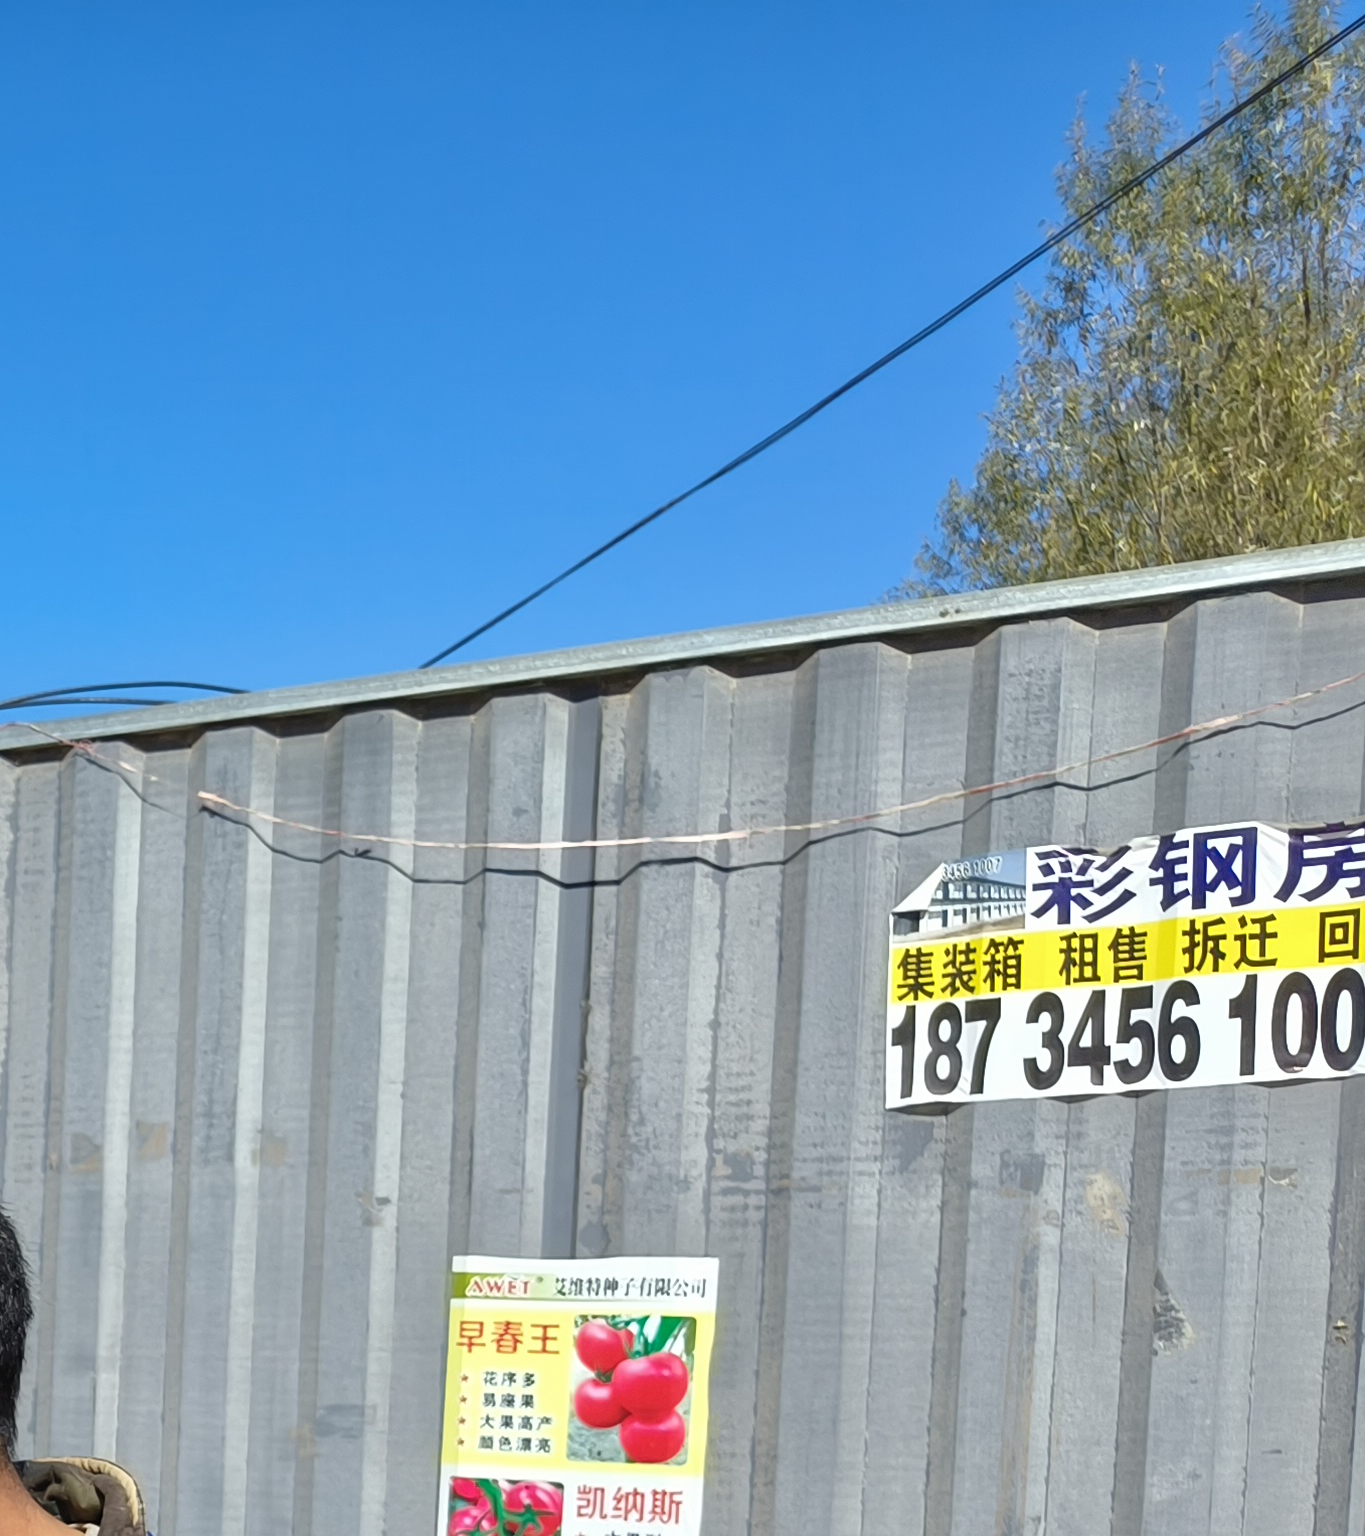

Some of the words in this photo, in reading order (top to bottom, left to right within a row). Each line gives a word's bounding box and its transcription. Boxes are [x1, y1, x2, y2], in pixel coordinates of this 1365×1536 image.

[1031, 821, 1365, 926] 彩钢房
[897, 936, 1024, 1001] 集装箱
[1059, 926, 1148, 985] 租售
[1181, 912, 1278, 974] 拆迁
[1319, 908, 1361, 963] 回
[891, 997, 1002, 1099] 187
[1023, 980, 1201, 1090] 3456
[1228, 968, 1365, 1076] 100
[554, 1277, 707, 1299] 艾维特种子有限公司
[456, 1320, 560, 1355] 早春王
[483, 1371, 535, 1388] 花序多
[479, 1413, 553, 1431] 大果高产
[478, 1435, 552, 1453] 颜色漂亮
[576, 1485, 683, 1524] 凯纳斯
